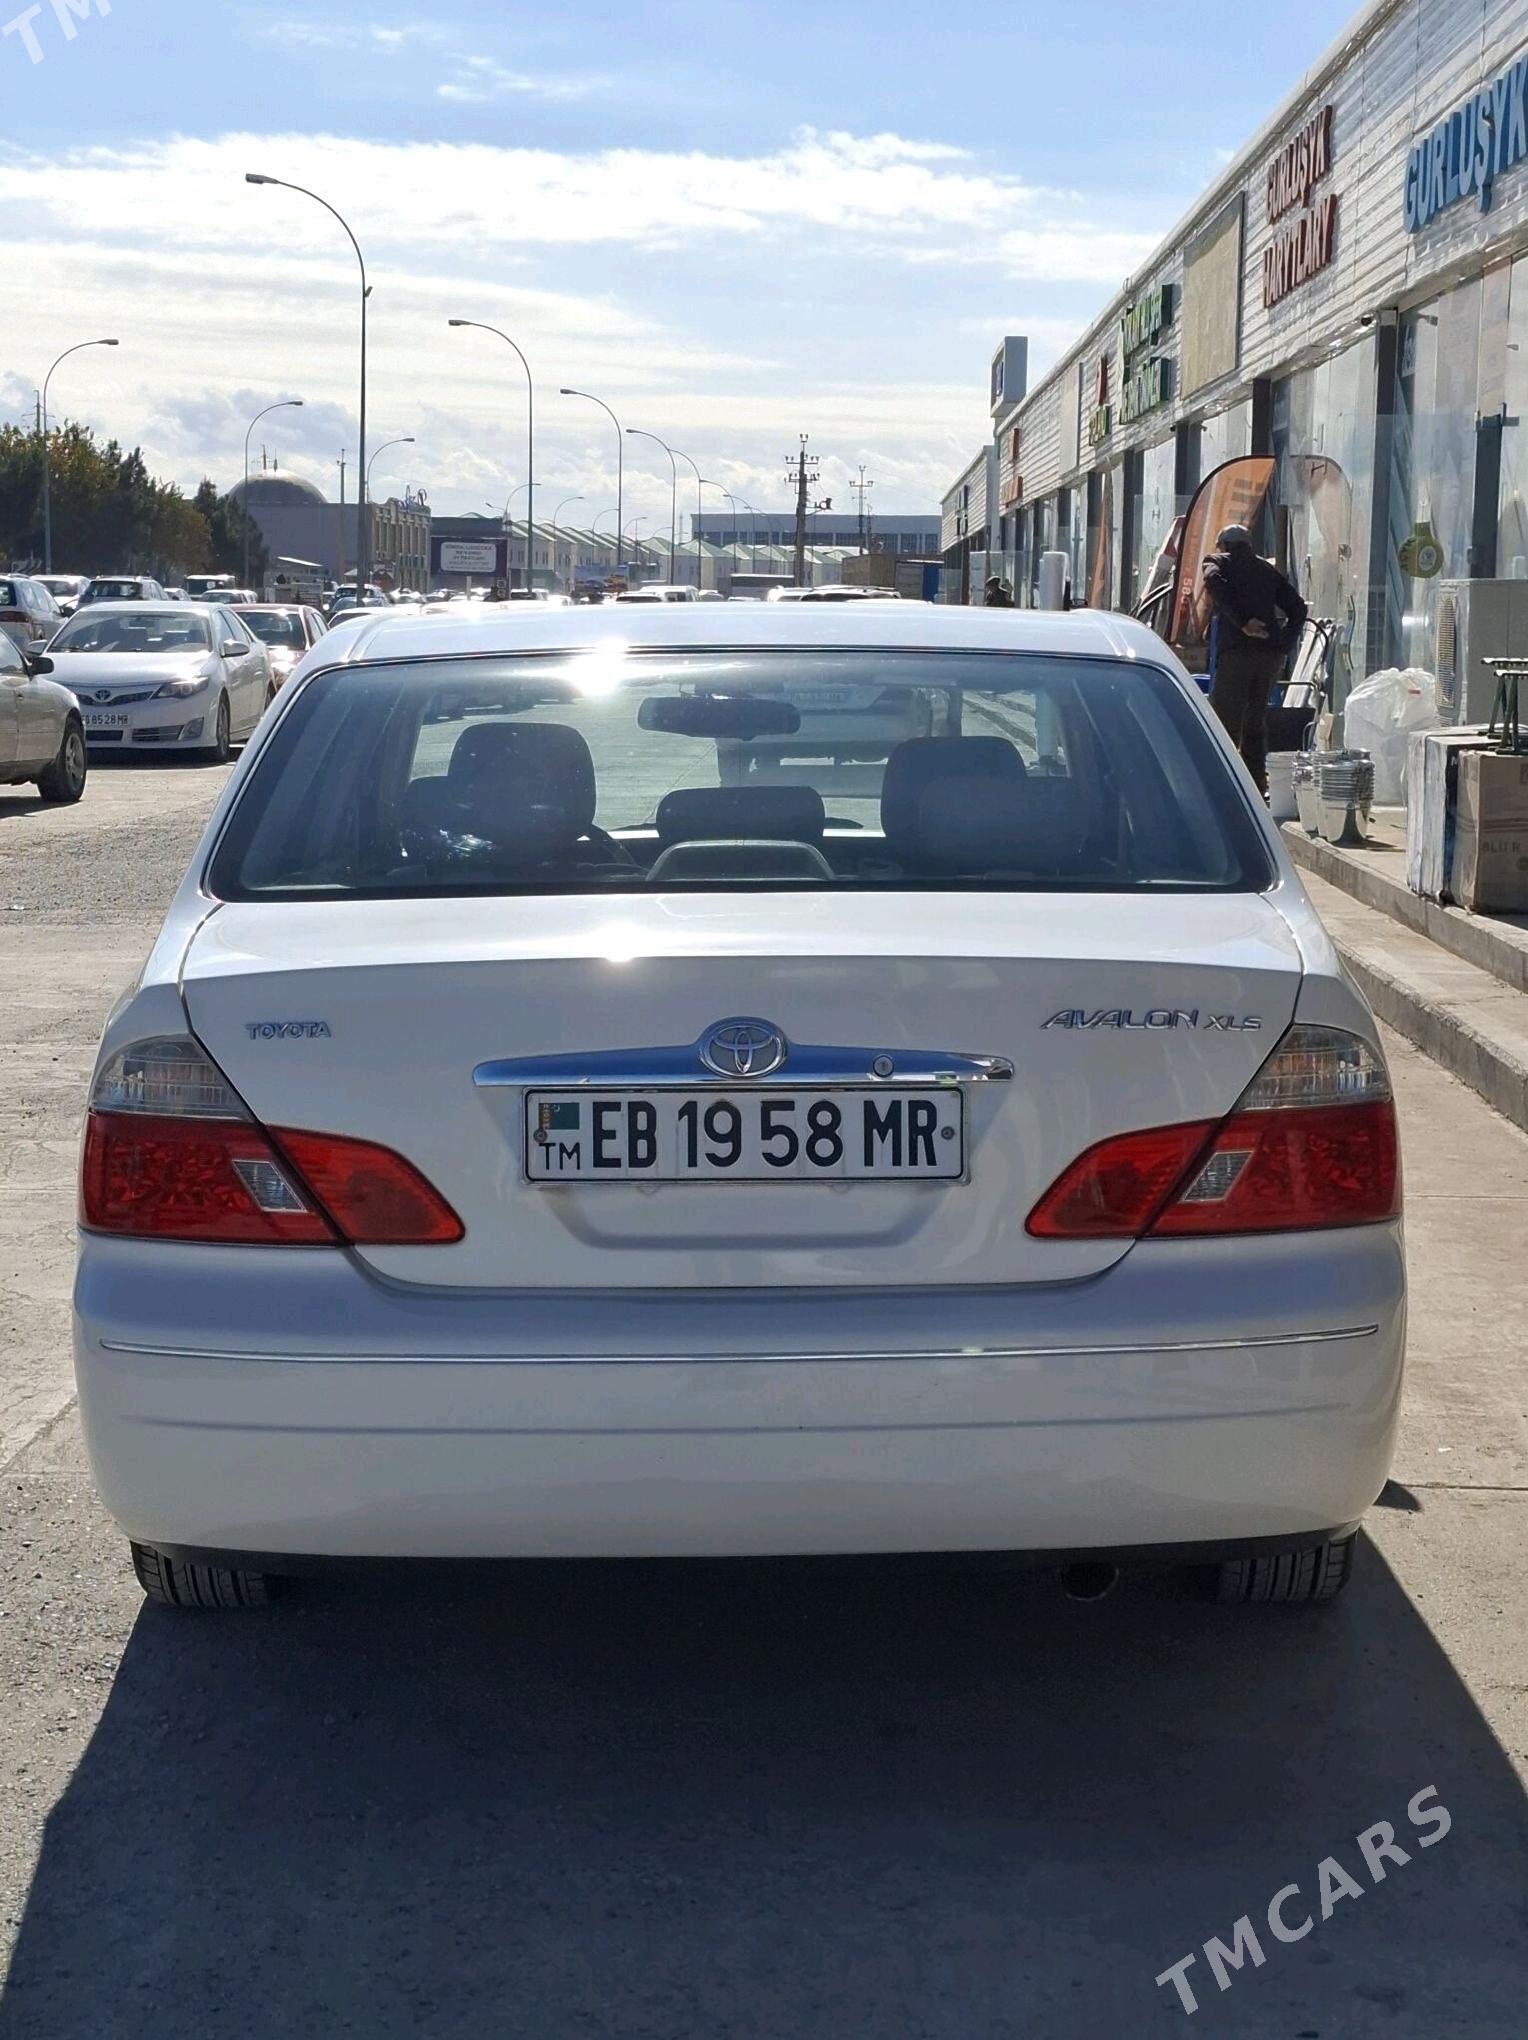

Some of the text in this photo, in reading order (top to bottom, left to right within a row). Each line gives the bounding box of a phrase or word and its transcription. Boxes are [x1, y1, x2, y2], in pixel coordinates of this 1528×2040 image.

[1266, 104, 1333, 225] GURLUŞYK
[1263, 193, 1337, 308] HARYTLARY
[245, 1021, 332, 1040] TOYOTA
[1039, 1009, 1263, 1032] AVALON XLS
[538, 1142, 581, 1170] TM
[592, 1101, 657, 1168] EB
[863, 1099, 938, 1167] MR
